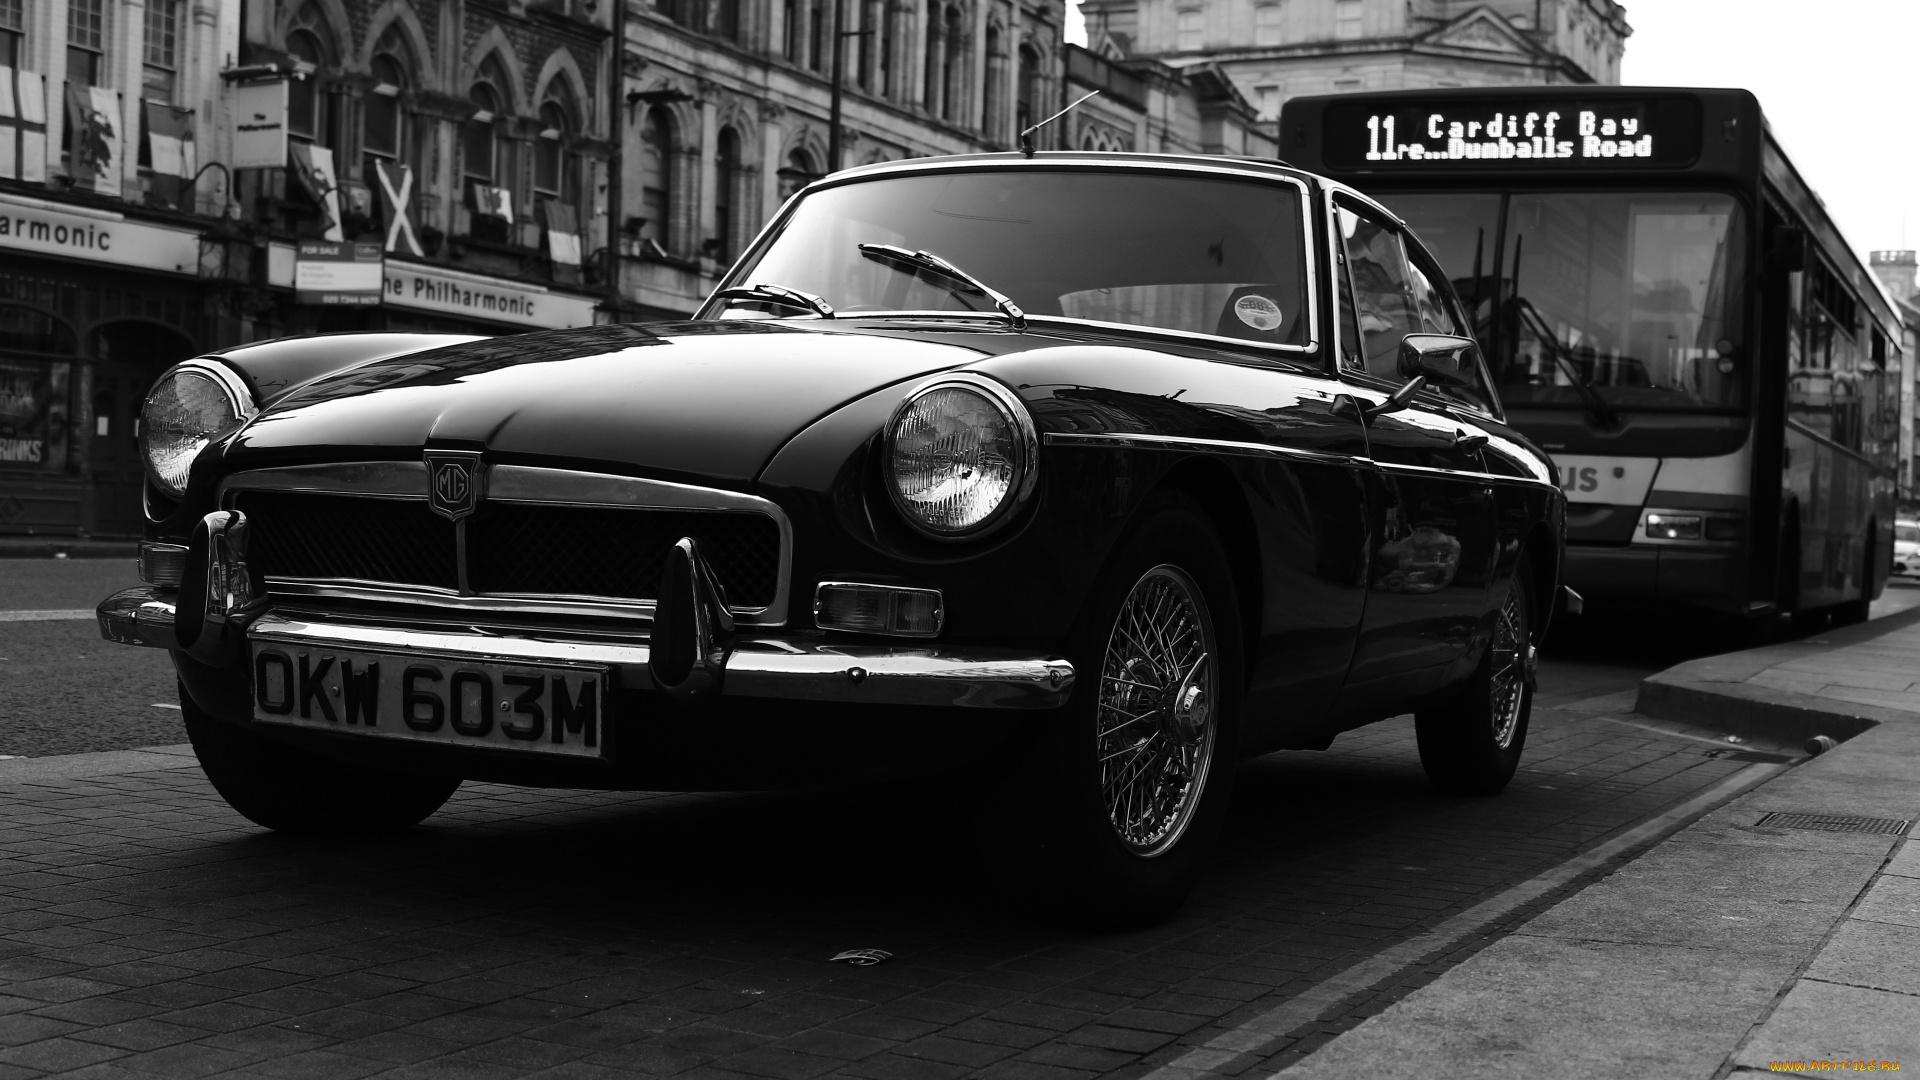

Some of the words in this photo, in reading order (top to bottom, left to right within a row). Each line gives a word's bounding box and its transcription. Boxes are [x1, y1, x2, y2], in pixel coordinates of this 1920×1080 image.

[1366, 115, 1397, 161] 11
[1428, 111, 1560, 139] Cardiff
[1579, 110, 1638, 136] Bay
[1582, 134, 1652, 157] Road
[319, 246, 340, 256] SALE
[414, 277, 536, 318] Philharmonic
[440, 468, 465, 499] MG
[255, 650, 379, 728] OKW
[402, 663, 597, 747] 603M
